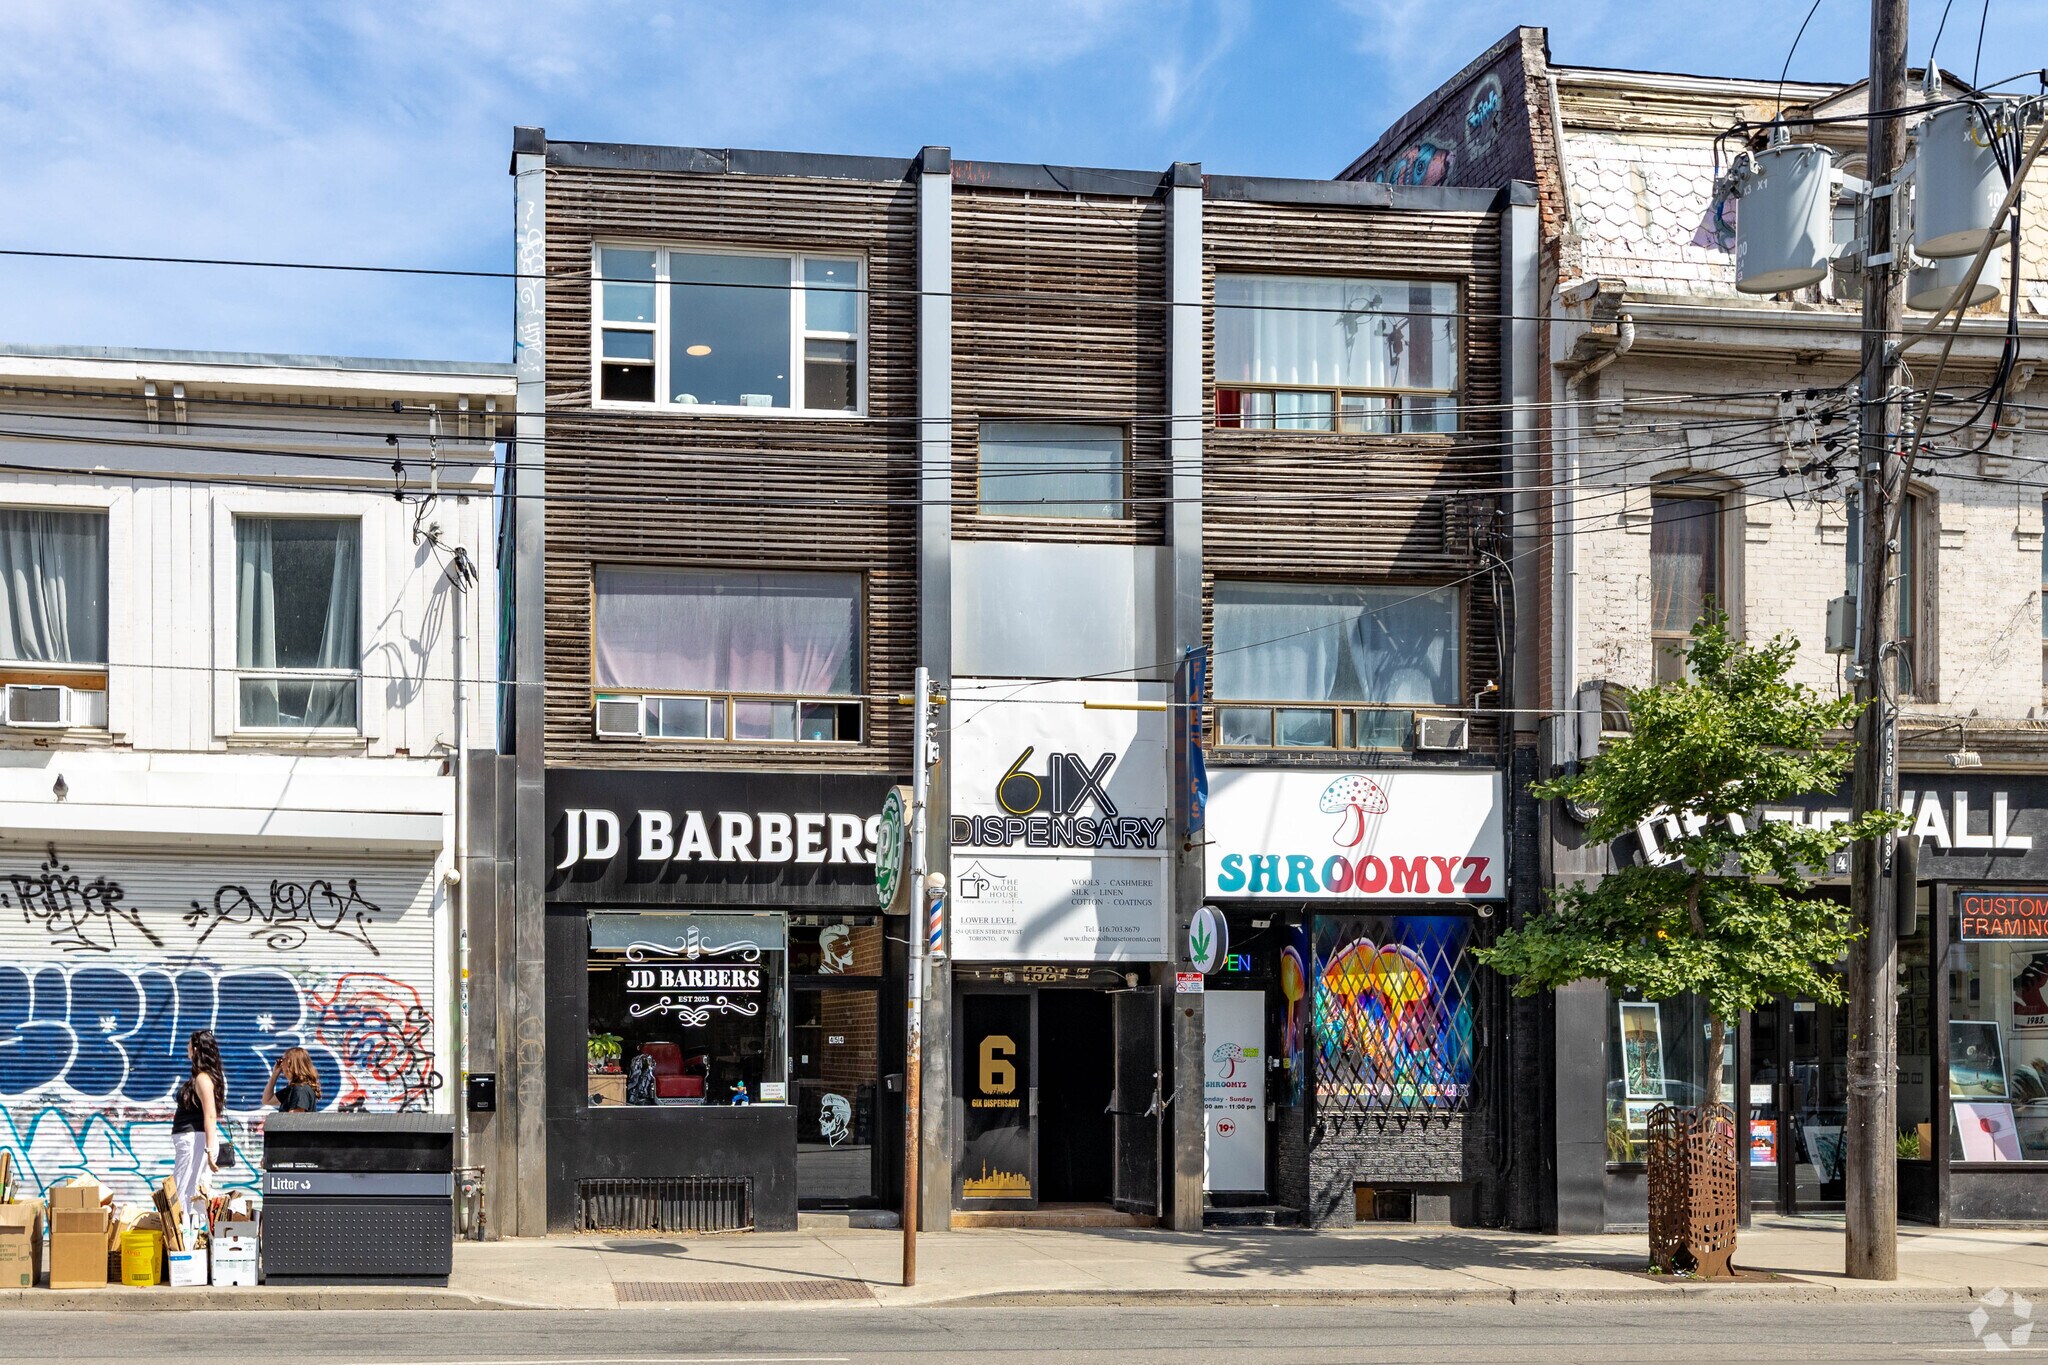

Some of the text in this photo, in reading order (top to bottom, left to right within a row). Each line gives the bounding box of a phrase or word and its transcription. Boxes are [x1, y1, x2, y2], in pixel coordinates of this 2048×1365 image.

[1757, 179, 1768, 191] X1
[997, 746, 1118, 816] 6IX
[557, 808, 621, 869] JD
[951, 815, 1165, 848] DISPENSARY
[1217, 853, 1492, 894] SHROOMYZ
[1110, 879, 1153, 887] CASHMERE
[1965, 897, 2048, 917] CUSTOM
[1063, 935, 1160, 943] www.thewoolhousetoronto.com
[626, 969, 760, 988] JD BARBERS
[1024, 965, 1056, 981] 452
[979, 1035, 1016, 1096] 6
[983, 1099, 1020, 1108] DISPENSARY
[1219, 1124, 1234, 1132] 19+
[271, 1177, 299, 1190] Litter
